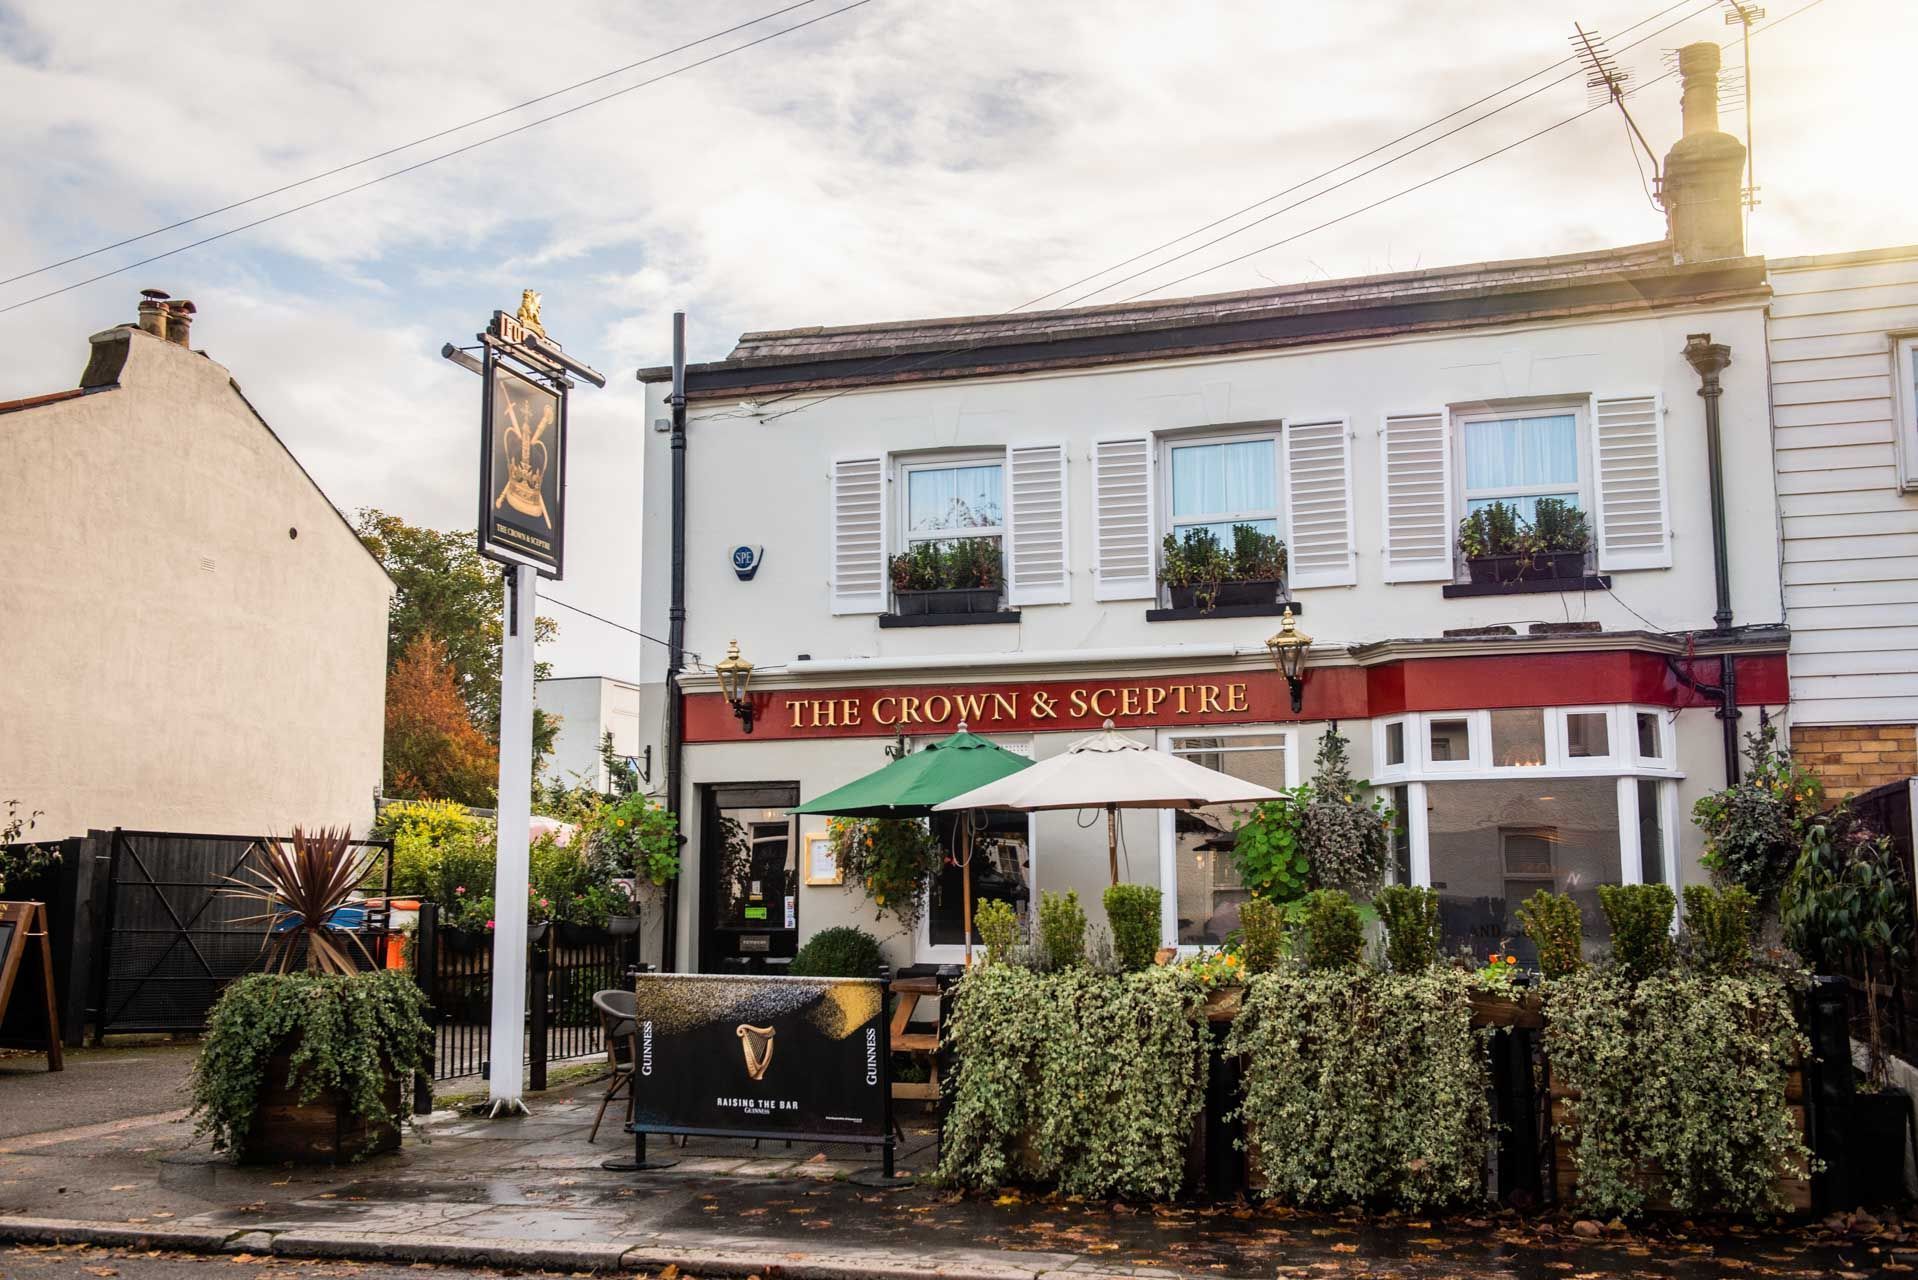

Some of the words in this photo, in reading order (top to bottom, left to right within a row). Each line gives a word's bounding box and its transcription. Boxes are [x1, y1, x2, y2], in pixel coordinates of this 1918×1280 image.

[508, 528, 527, 540] CROWN
[736, 552, 752, 565] SPE
[786, 699, 862, 728] THE
[872, 692, 1020, 725] CROWN
[1030, 691, 1058, 718] &
[1069, 683, 1249, 718] SCEPTRE
[641, 1020, 653, 1076] GUINNESS
[866, 1027, 878, 1086] GUINNESS
[716, 1097, 755, 1108] RAISING
[757, 1099, 776, 1109] THE
[779, 1101, 799, 1110] BAR
